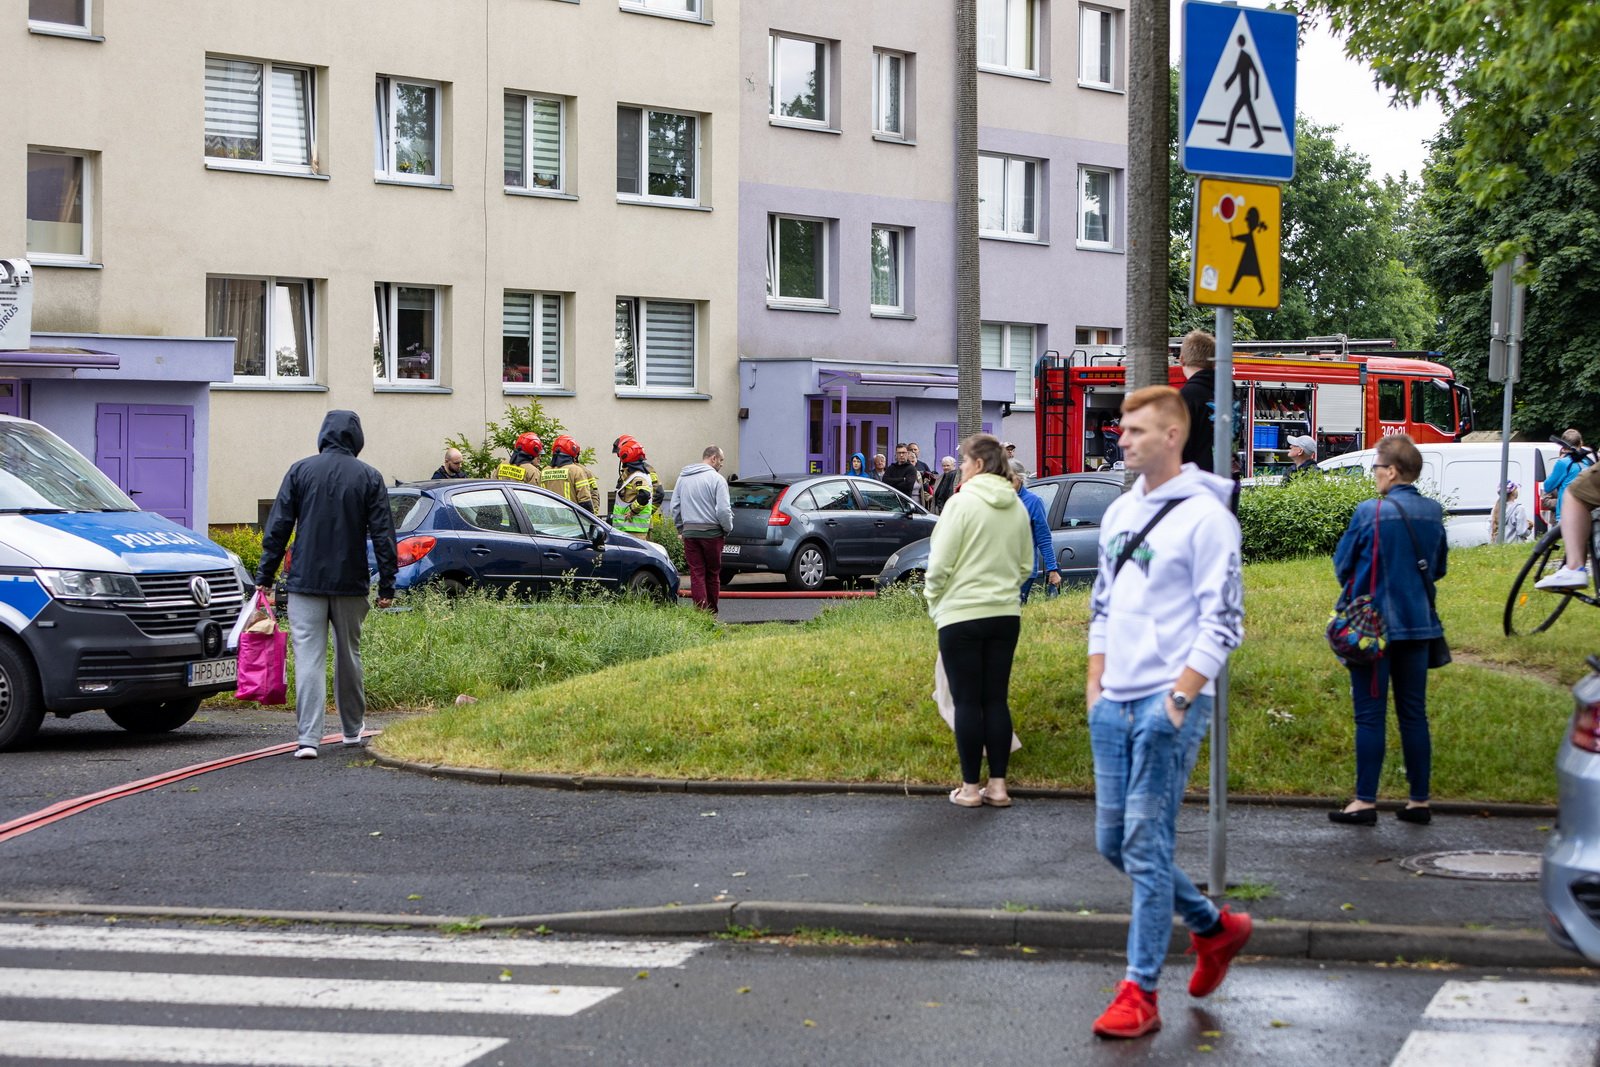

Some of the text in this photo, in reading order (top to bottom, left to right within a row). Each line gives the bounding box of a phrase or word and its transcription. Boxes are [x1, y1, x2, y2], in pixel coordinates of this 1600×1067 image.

[112, 532, 202, 549] POLICJA
[194, 660, 236, 681] HPB C963
